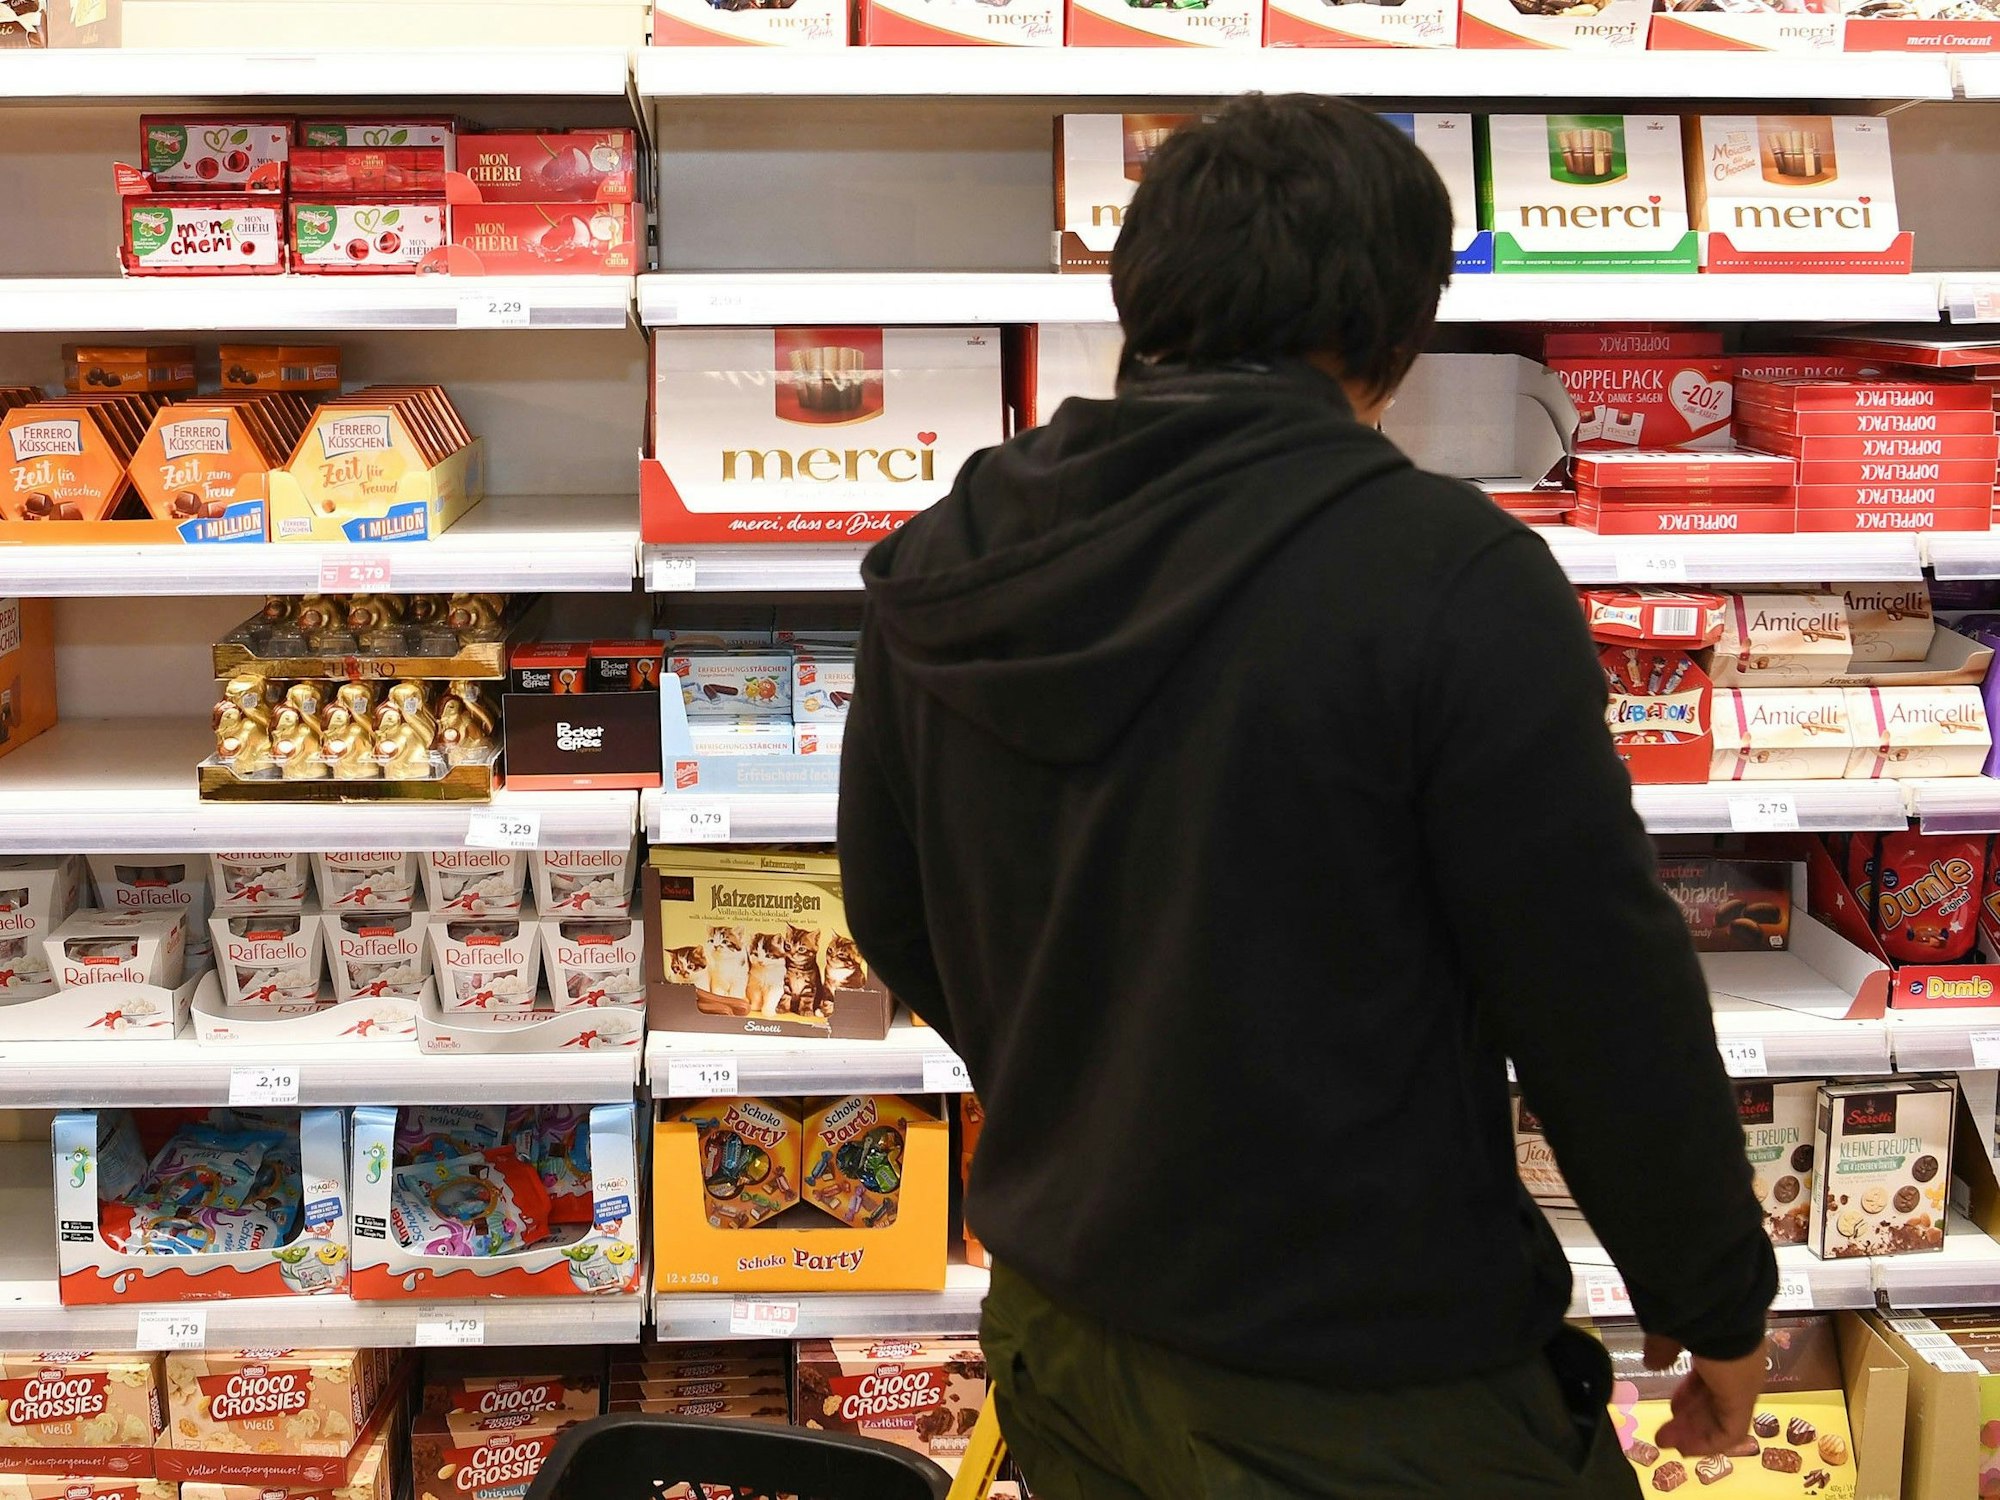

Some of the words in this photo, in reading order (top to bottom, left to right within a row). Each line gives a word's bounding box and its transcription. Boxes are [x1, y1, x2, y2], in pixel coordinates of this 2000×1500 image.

[769, 12, 832, 29] merci
[987, 10, 1051, 26] merci
[1188, 12, 1249, 28] merci
[1381, 10, 1442, 25] merci
[1575, 22, 1636, 36] merci
[1779, 24, 1836, 38] merci
[1906, 34, 1940, 46] merci
[1943, 33, 1992, 47] Crocant
[479, 152, 509, 166] MON
[1520, 195, 1662, 228] merci
[1734, 197, 1872, 229] merci
[475, 222, 505, 235] MON
[171, 233, 232, 255] chéri
[488, 301, 522, 314] 2,29
[1600, 336, 1670, 351] DOPPELPACK
[1559, 368, 1664, 390] DOPPELPACK
[1588, 391, 1604, 403] 2X
[1607, 392, 1633, 404] DANKE
[1635, 393, 1663, 403] SAGEN
[1682, 384, 1724, 411] -20%
[1856, 390, 1934, 406] DOPPELPACK
[173, 424, 221, 438] FERRERO
[333, 423, 381, 435] FERRERO
[1858, 416, 1936, 431] DOPPELPACK
[23, 426, 72, 439] FERRERO
[19, 438, 76, 452] KÜSSCHEN
[169, 436, 224, 450] KÜSSCHEN
[328, 435, 385, 448] KÜSSCHEN
[1863, 440, 1941, 455] DOPPELPACK
[722, 431, 934, 482] merci
[10, 460, 54, 491] Zeit
[57, 469, 75, 485] für
[160, 459, 203, 490] Zeit
[206, 470, 232, 481] zum
[319, 457, 362, 487] Zeit
[366, 464, 384, 478] für
[1861, 465, 1939, 480] DOPPELPACK
[53, 484, 101, 499] Küsschen
[360, 481, 398, 495] Freund
[1857, 489, 1935, 504] DOPPELPACK
[196, 524, 203, 539] 1
[207, 512, 261, 537] MILLION
[359, 524, 366, 538] 1
[370, 513, 424, 537] MILLION
[729, 517, 783, 534] merci,
[787, 515, 822, 533] dass
[825, 519, 841, 531] es
[846, 513, 890, 535] Dich
[1658, 514, 1738, 530] DOPPELPACK
[1856, 513, 1934, 528] DOPPELPACK
[665, 560, 692, 569] 5,79
[1646, 559, 1677, 570] 4,99
[350, 567, 384, 580] 2,79
[1842, 591, 1923, 611] Amicelli
[1751, 610, 1840, 632] Amicelli
[601, 660, 629, 670] Pocket
[601, 668, 627, 677] Coffee
[522, 671, 551, 681] Pocket
[1822, 677, 1873, 685] Amicelli
[522, 680, 550, 688] Coffee
[1751, 705, 1838, 726] Amicelli
[1889, 703, 1976, 725] Amicelli
[557, 722, 604, 738] Pocket
[557, 737, 602, 750] Coffee
[738, 768, 806, 782] Erfrischend
[1758, 803, 1788, 815] 2,79
[690, 813, 722, 824] 0,79
[499, 823, 532, 835] 3,29
[432, 850, 510, 868] Raffaello
[544, 850, 622, 867] Raffaello
[761, 857, 806, 870] Katzenzungen
[116, 889, 192, 906] Raffaello
[711, 884, 821, 914] Katzenzungen
[1878, 858, 1974, 930] Dumle
[1938, 890, 1971, 916] original
[717, 907, 790, 918] Vollmilch-Schokolade
[229, 943, 307, 962] Raffaello
[340, 938, 418, 957] Raffaello
[446, 948, 524, 965] Raffaello
[558, 947, 636, 964] Raffaello
[64, 967, 144, 986] Raffaello
[1928, 975, 1993, 998] Dumle
[744, 1021, 781, 1033] Sarotti
[427, 1040, 461, 1049] Raffaello
[1727, 1048, 1757, 1060] 1,19
[260, 1076, 291, 1089] 2,19
[699, 1070, 730, 1083] 1,19
[742, 1102, 781, 1127] Schoko
[824, 1096, 863, 1128] Schoko
[1847, 1110, 1893, 1126] Sarotti
[724, 1105, 787, 1148] Party
[820, 1097, 878, 1147] Party
[1756, 1127, 1800, 1146] FREUDEN
[1839, 1141, 1875, 1158] KLEINE
[1877, 1137, 1922, 1155] FREUDEN
[391, 1208, 412, 1248] Kinder
[738, 1254, 786, 1271] Schoko
[792, 1247, 865, 1271] Party
[666, 1274, 679, 1284] 12
[680, 1276, 687, 1284] x
[690, 1273, 710, 1284] 250
[712, 1276, 719, 1286] g
[760, 1306, 791, 1320] 1,99
[168, 1324, 198, 1338] 1,79
[445, 1320, 477, 1333] 1,79
[24, 1378, 92, 1403] CHOCO
[226, 1374, 294, 1398] CHOCO
[858, 1371, 931, 1397] CHOCO
[211, 1391, 306, 1419] CROSSIES
[480, 1386, 546, 1414] CHOCO
[842, 1388, 940, 1420] CROSSIES
[10, 1394, 103, 1423] CROSSIES
[40, 1423, 73, 1435] Weiß
[243, 1419, 275, 1431] Weiß
[862, 1416, 914, 1429] Zartbitter
[472, 1441, 541, 1468] CHOCO
[25, 1456, 106, 1471] Knuspergenuss!
[186, 1464, 217, 1476] Voller
[219, 1464, 301, 1478] Knuspergenuss!
[479, 1484, 527, 1499] Original
